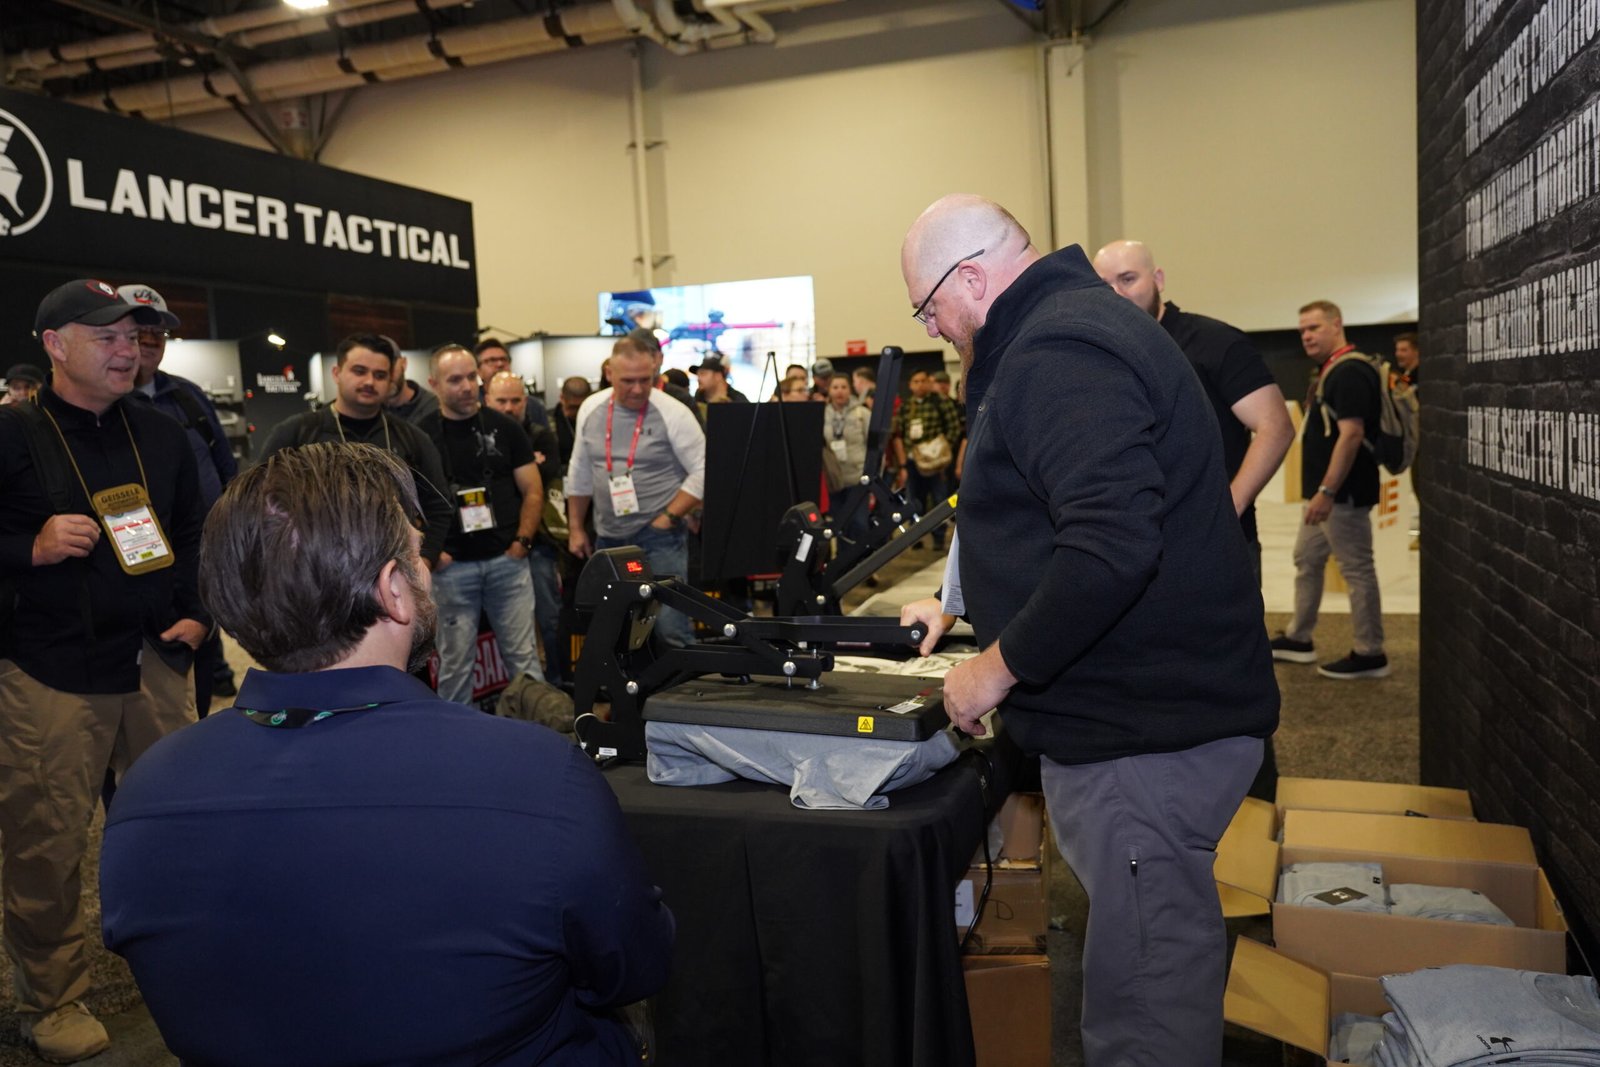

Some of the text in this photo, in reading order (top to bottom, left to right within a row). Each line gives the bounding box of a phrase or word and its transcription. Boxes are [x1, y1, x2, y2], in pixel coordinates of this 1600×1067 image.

[67, 158, 470, 270] LANCER TACTICAL
[1482, 153, 1535, 251] MAXIMUM
[1536, 99, 1600, 223] MOBILITY
[1483, 281, 1541, 361] INCREDIBLE
[1541, 259, 1600, 355] TOUGHN
[1484, 406, 1501, 472] THE
[1501, 407, 1537, 482] SELECT
[1538, 410, 1565, 490] FEW
